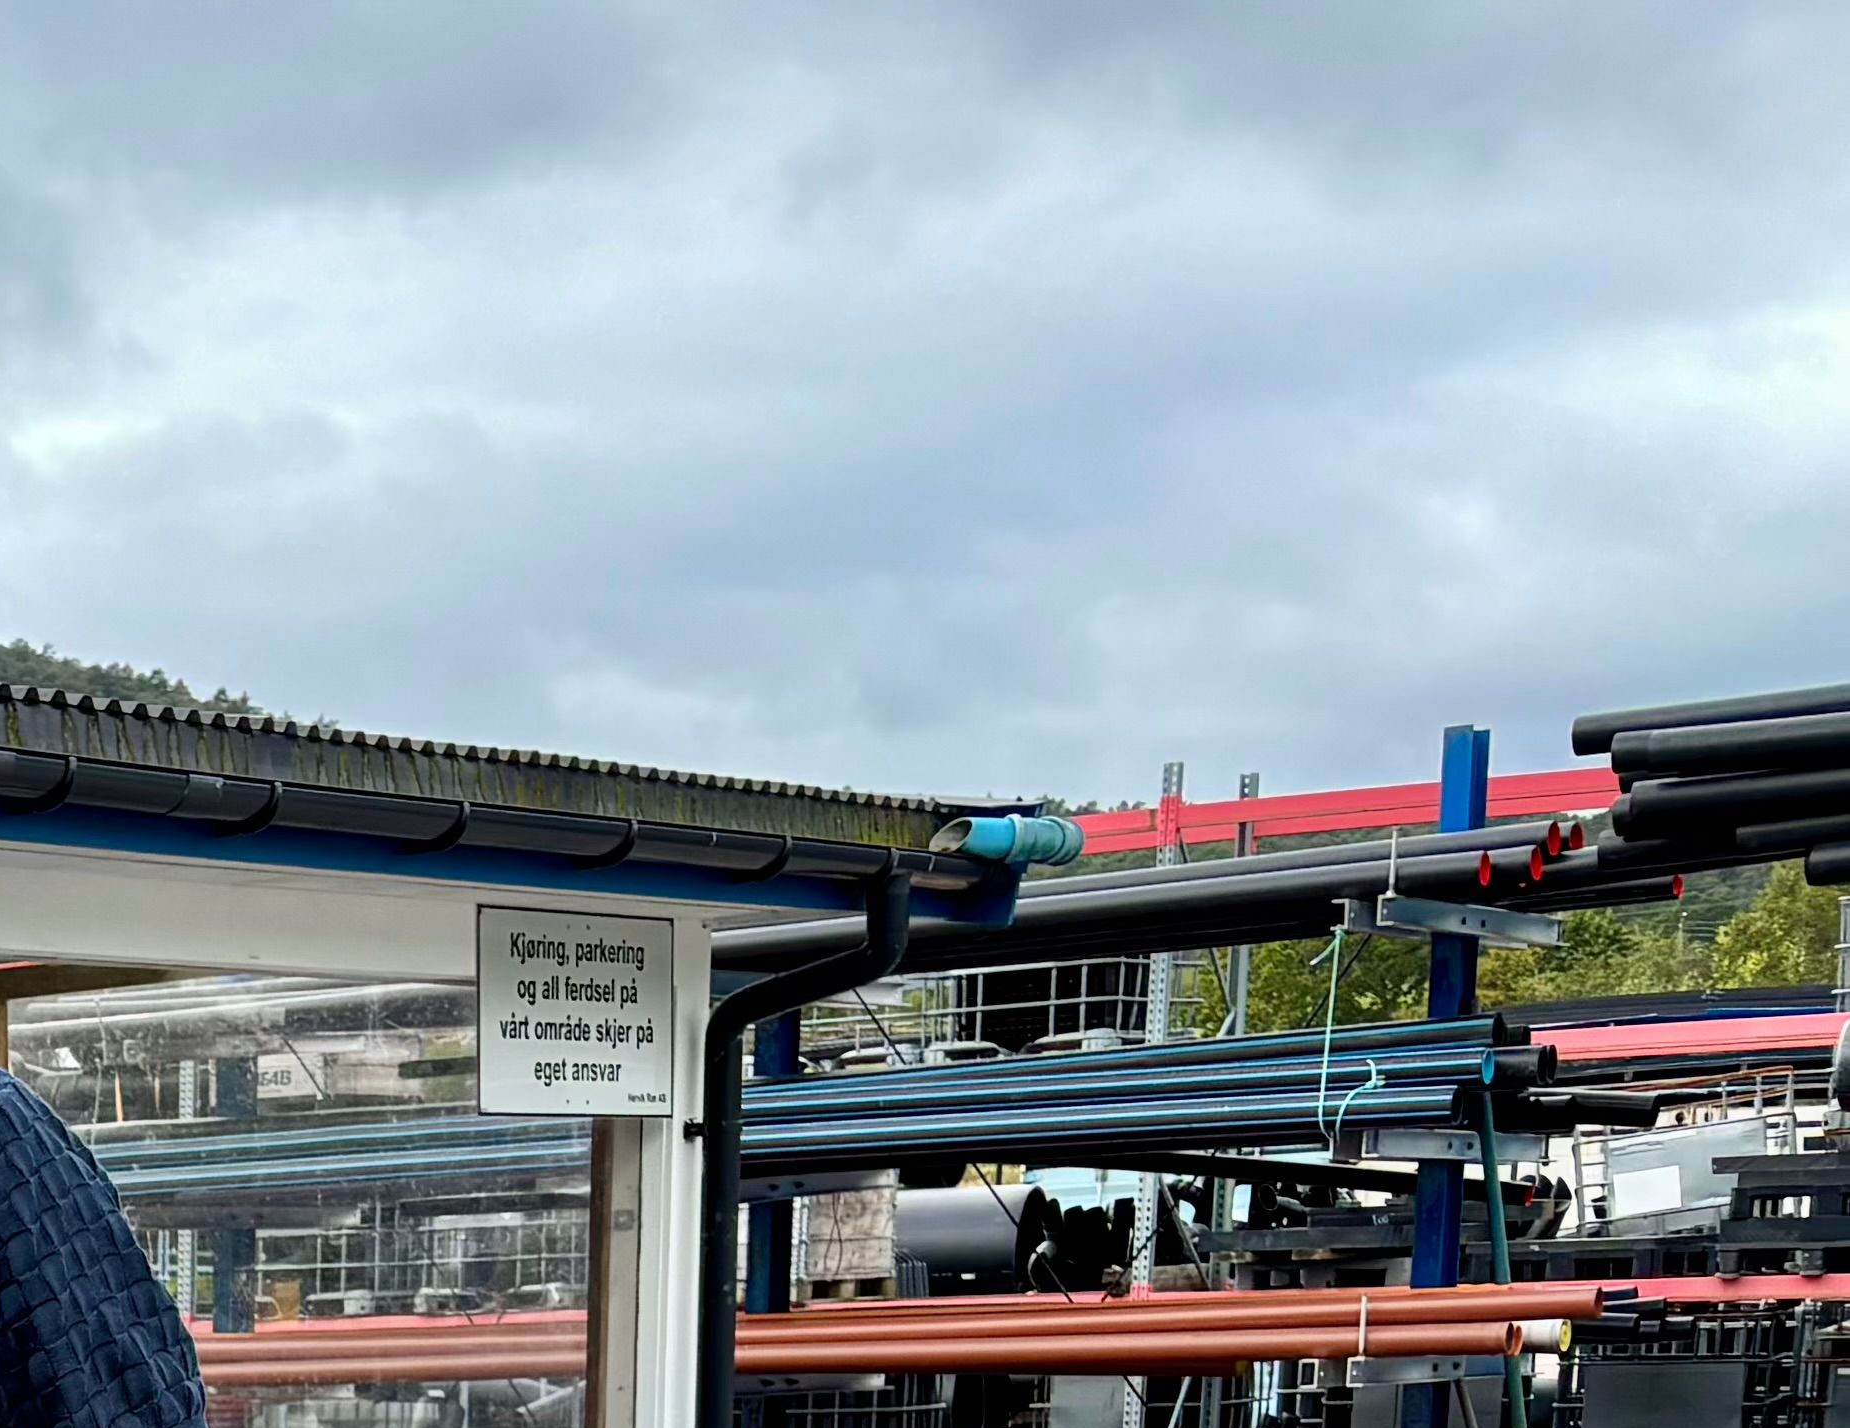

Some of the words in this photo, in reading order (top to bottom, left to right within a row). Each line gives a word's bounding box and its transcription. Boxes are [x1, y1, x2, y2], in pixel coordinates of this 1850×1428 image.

[509, 932, 570, 966] Kjøring,
[575, 938, 645, 971] parkering
[517, 980, 536, 1006] og
[541, 976, 560, 1001] all
[564, 976, 615, 1003] ferdsel
[620, 978, 638, 1010] på
[499, 1012, 530, 1040] vårt
[534, 1015, 591, 1042] område
[596, 1018, 633, 1050] skjer
[636, 1018, 654, 1050] på
[534, 1057, 568, 1087] eget
[571, 1062, 622, 1082] ansvar
